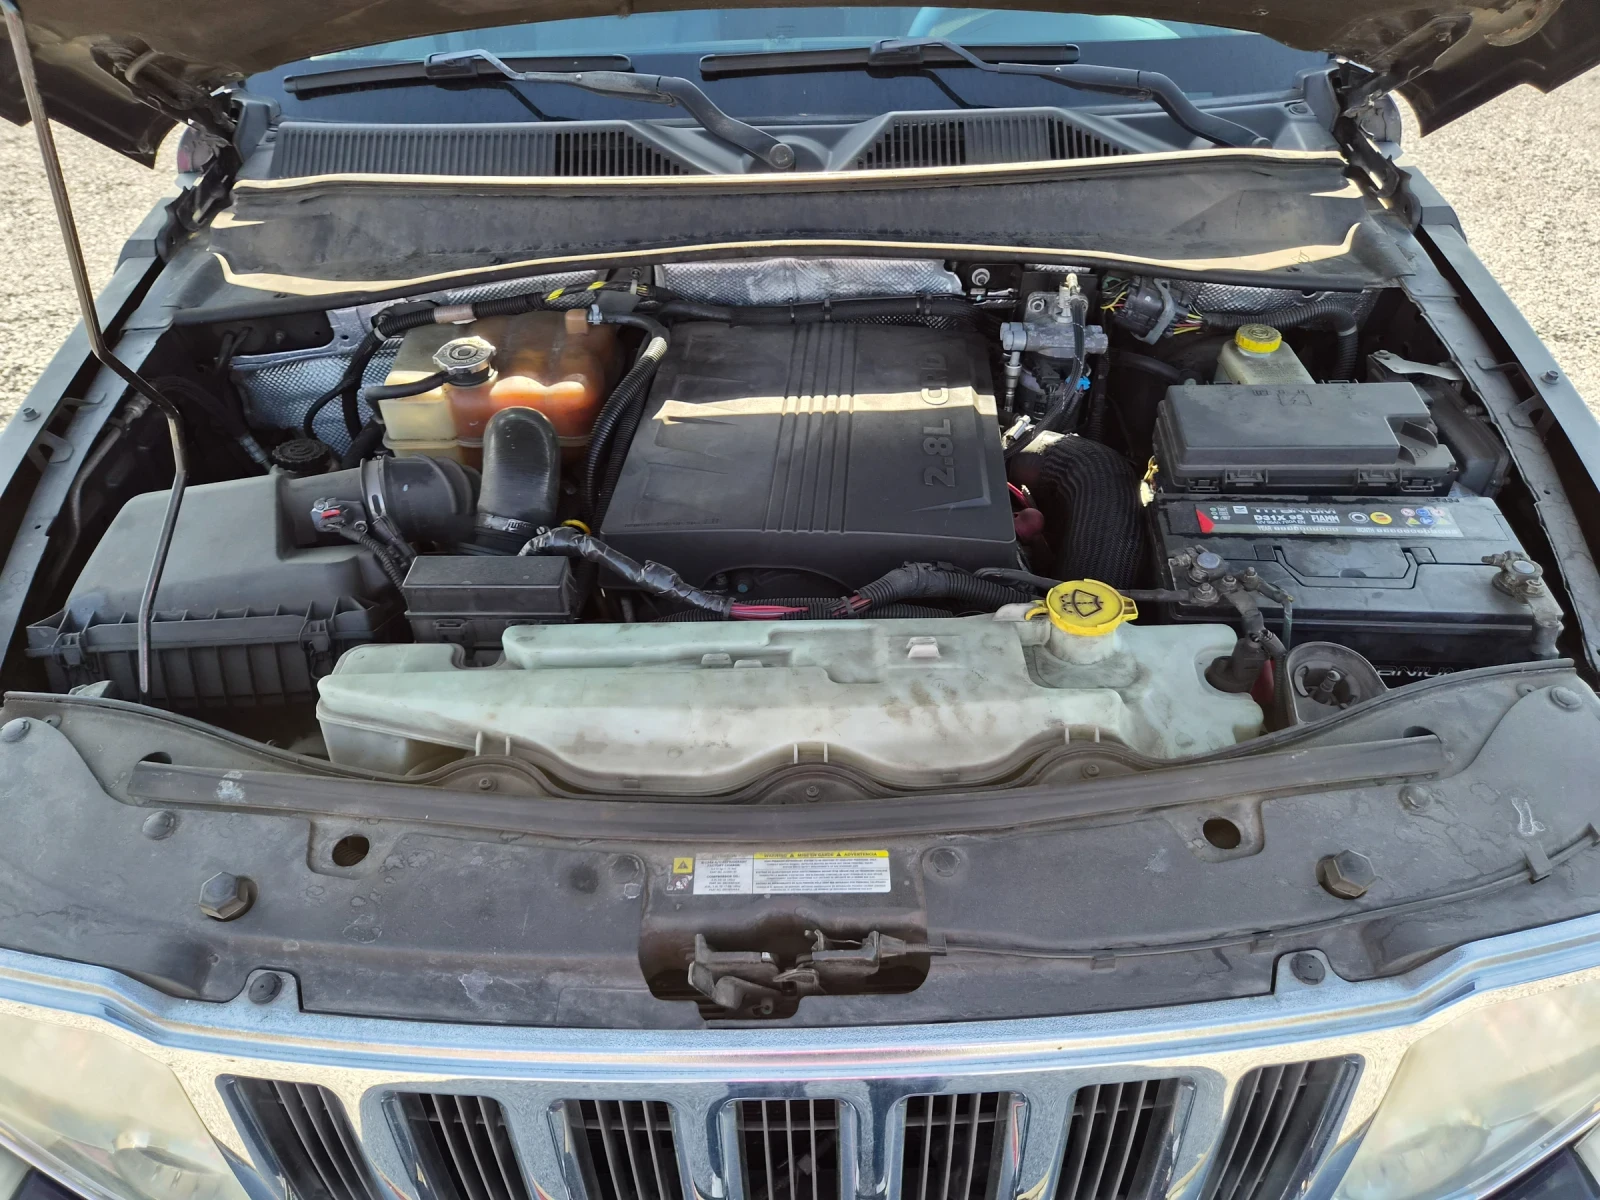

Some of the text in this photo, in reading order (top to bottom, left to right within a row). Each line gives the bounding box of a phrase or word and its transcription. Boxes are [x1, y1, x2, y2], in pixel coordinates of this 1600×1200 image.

[920, 352, 956, 488] 2.8L CRD
[1311, 514, 1340, 523] FIAMM
